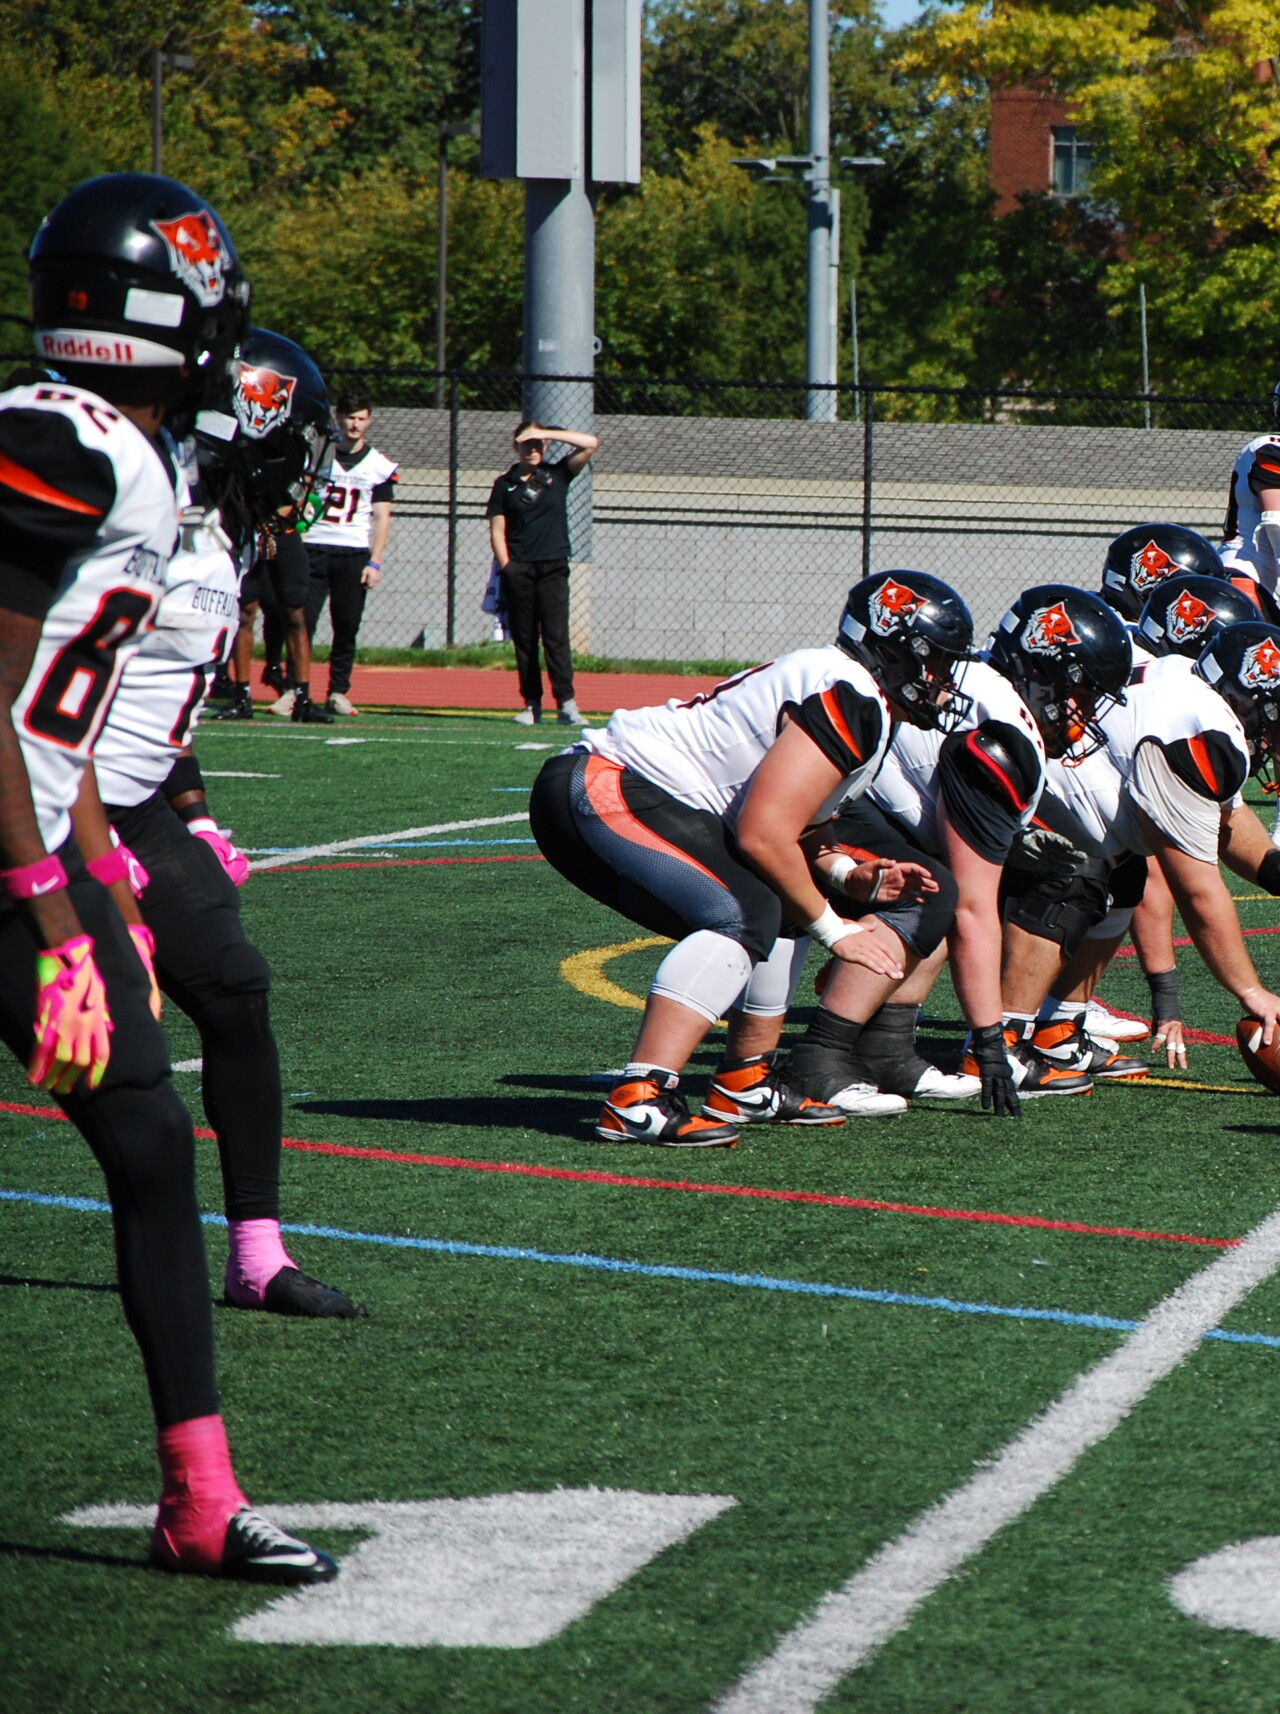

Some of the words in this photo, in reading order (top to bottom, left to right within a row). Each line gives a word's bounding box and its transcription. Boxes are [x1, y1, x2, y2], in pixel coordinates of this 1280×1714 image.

[42, 334, 134, 363] Riddell
[320, 485, 361, 524] 21
[24, 586, 156, 757] 8
